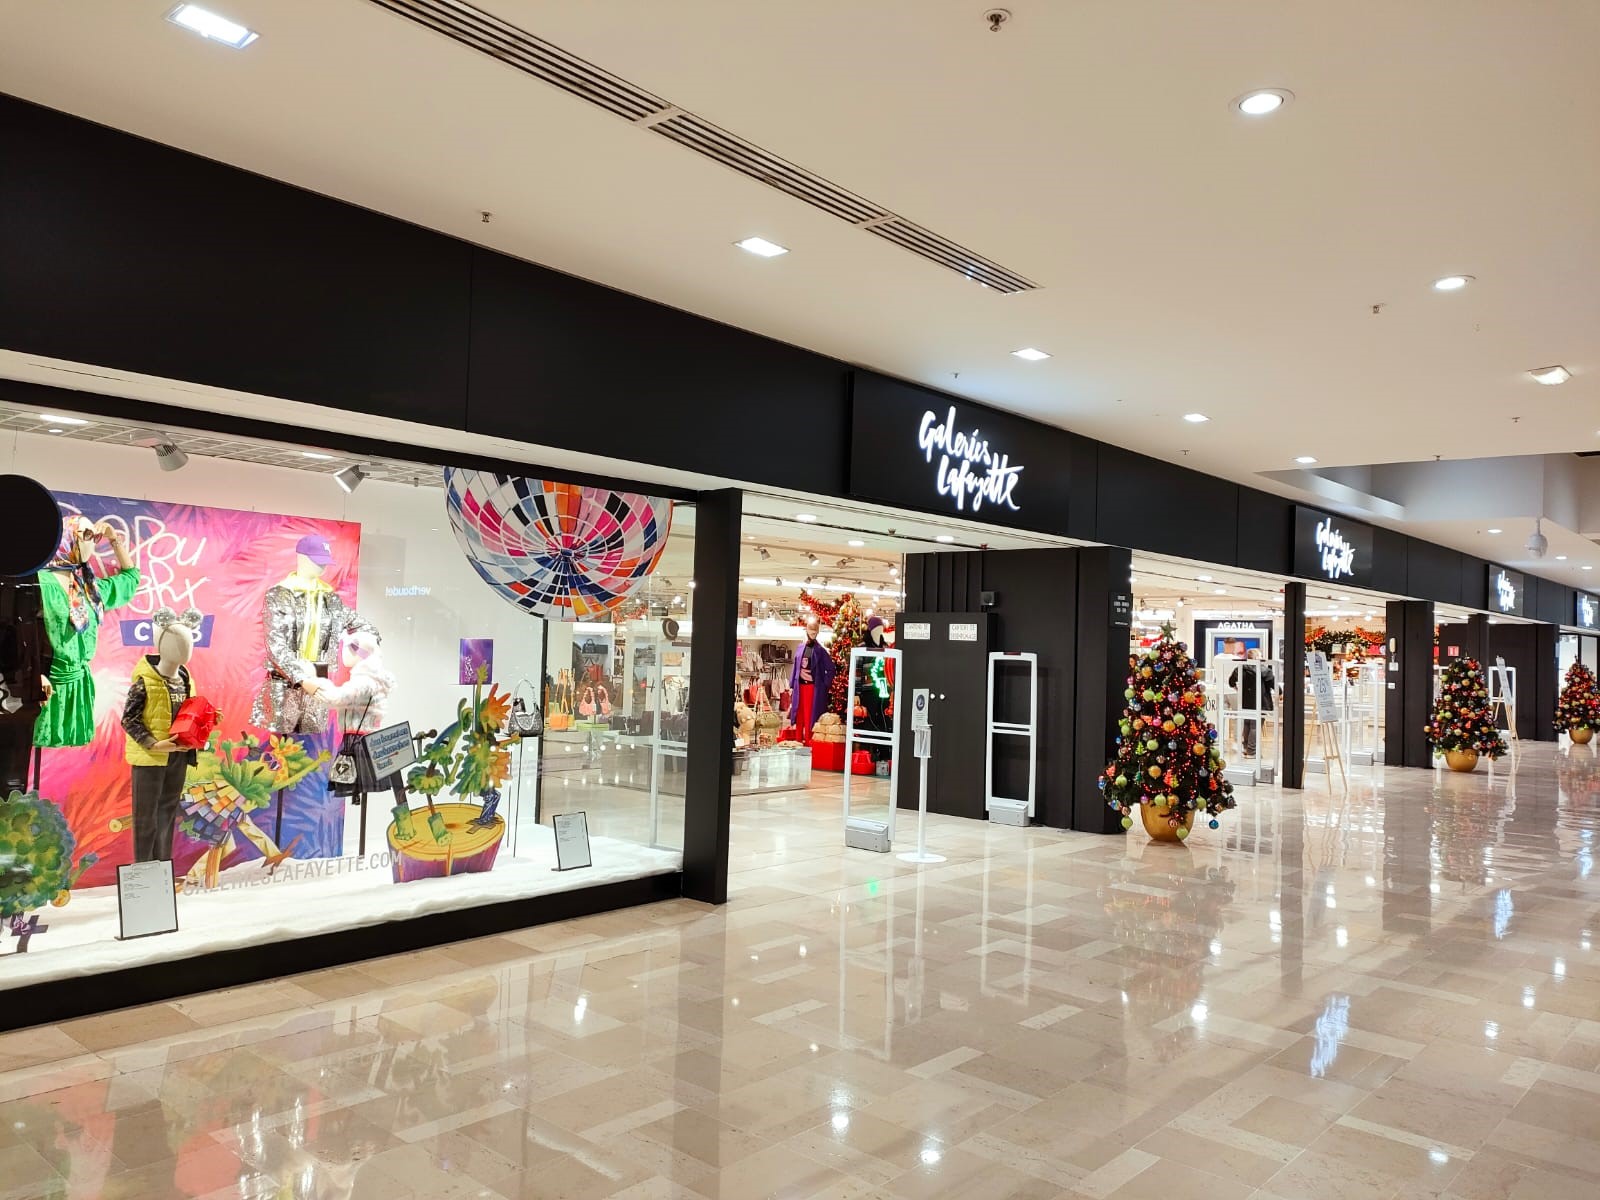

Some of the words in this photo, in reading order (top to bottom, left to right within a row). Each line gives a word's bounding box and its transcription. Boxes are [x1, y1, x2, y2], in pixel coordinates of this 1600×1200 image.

[919, 405, 992, 465] Galeries
[937, 452, 1025, 512] Lafayette
[1217, 621, 1256, 630] AGATHA
